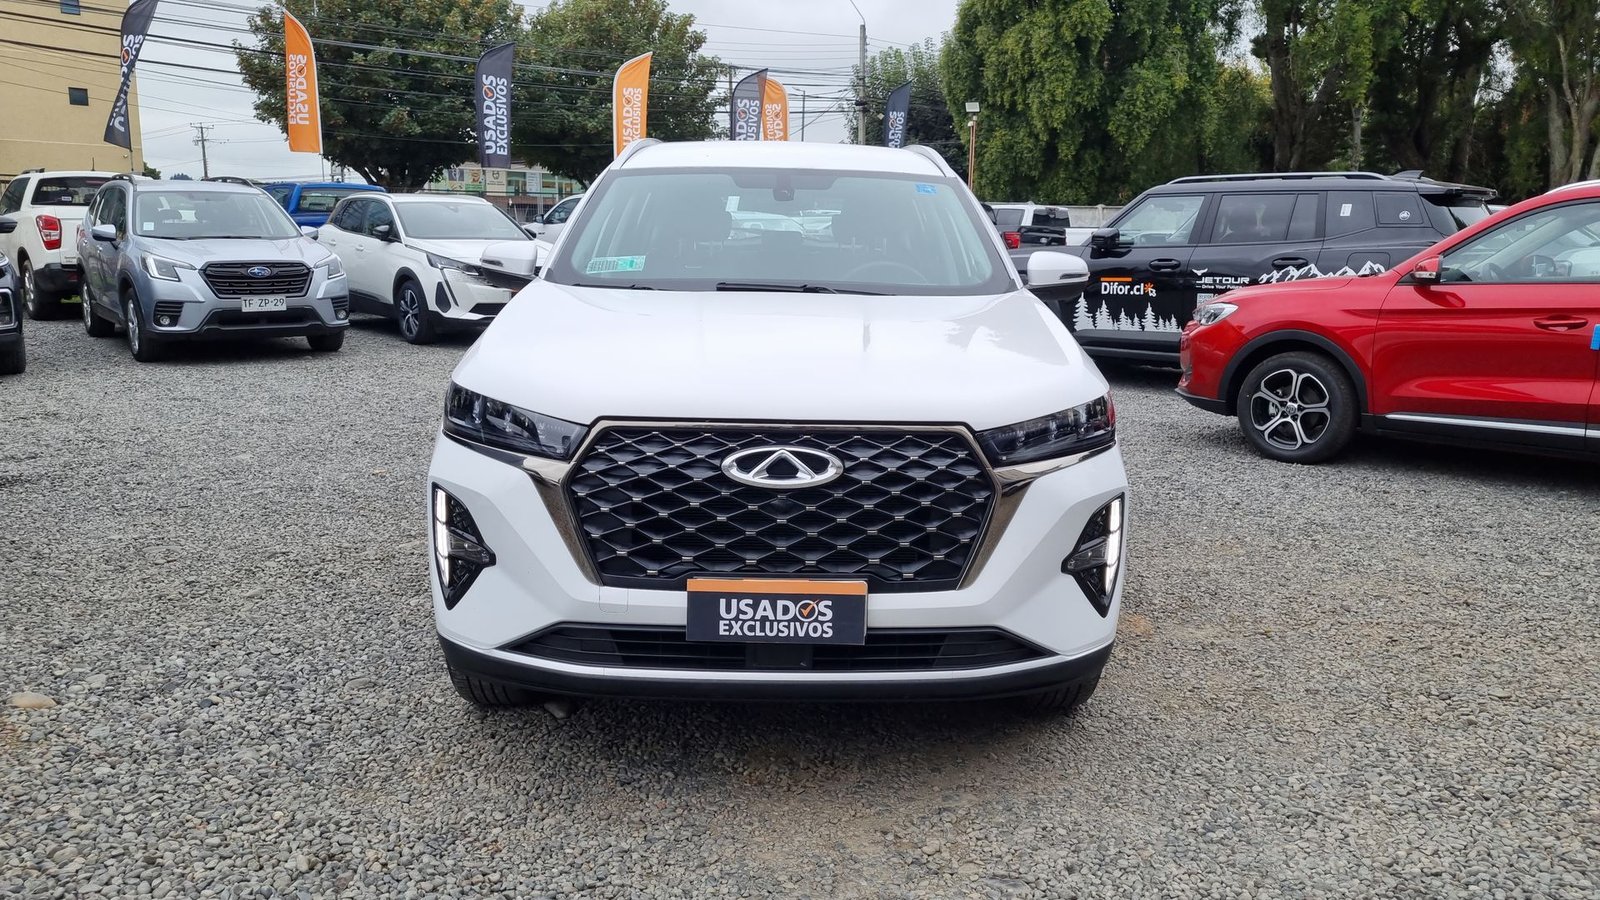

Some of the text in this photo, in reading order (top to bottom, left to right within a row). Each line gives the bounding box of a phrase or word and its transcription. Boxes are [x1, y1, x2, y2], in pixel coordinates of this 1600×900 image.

[482, 74, 497, 155] USADOS
[496, 77, 508, 156] EXCLUSIVOS
[622, 87, 634, 146] USADOS
[632, 87, 642, 141] XCLUSIVOS
[735, 99, 750, 141] ADOS
[746, 100, 760, 141] USIVOS
[888, 111, 898, 148] ADOS
[1195, 276, 1250, 284] JETOUR
[718, 620, 833, 638] EXCLUSIVOS
[719, 598, 833, 622] USADOS
